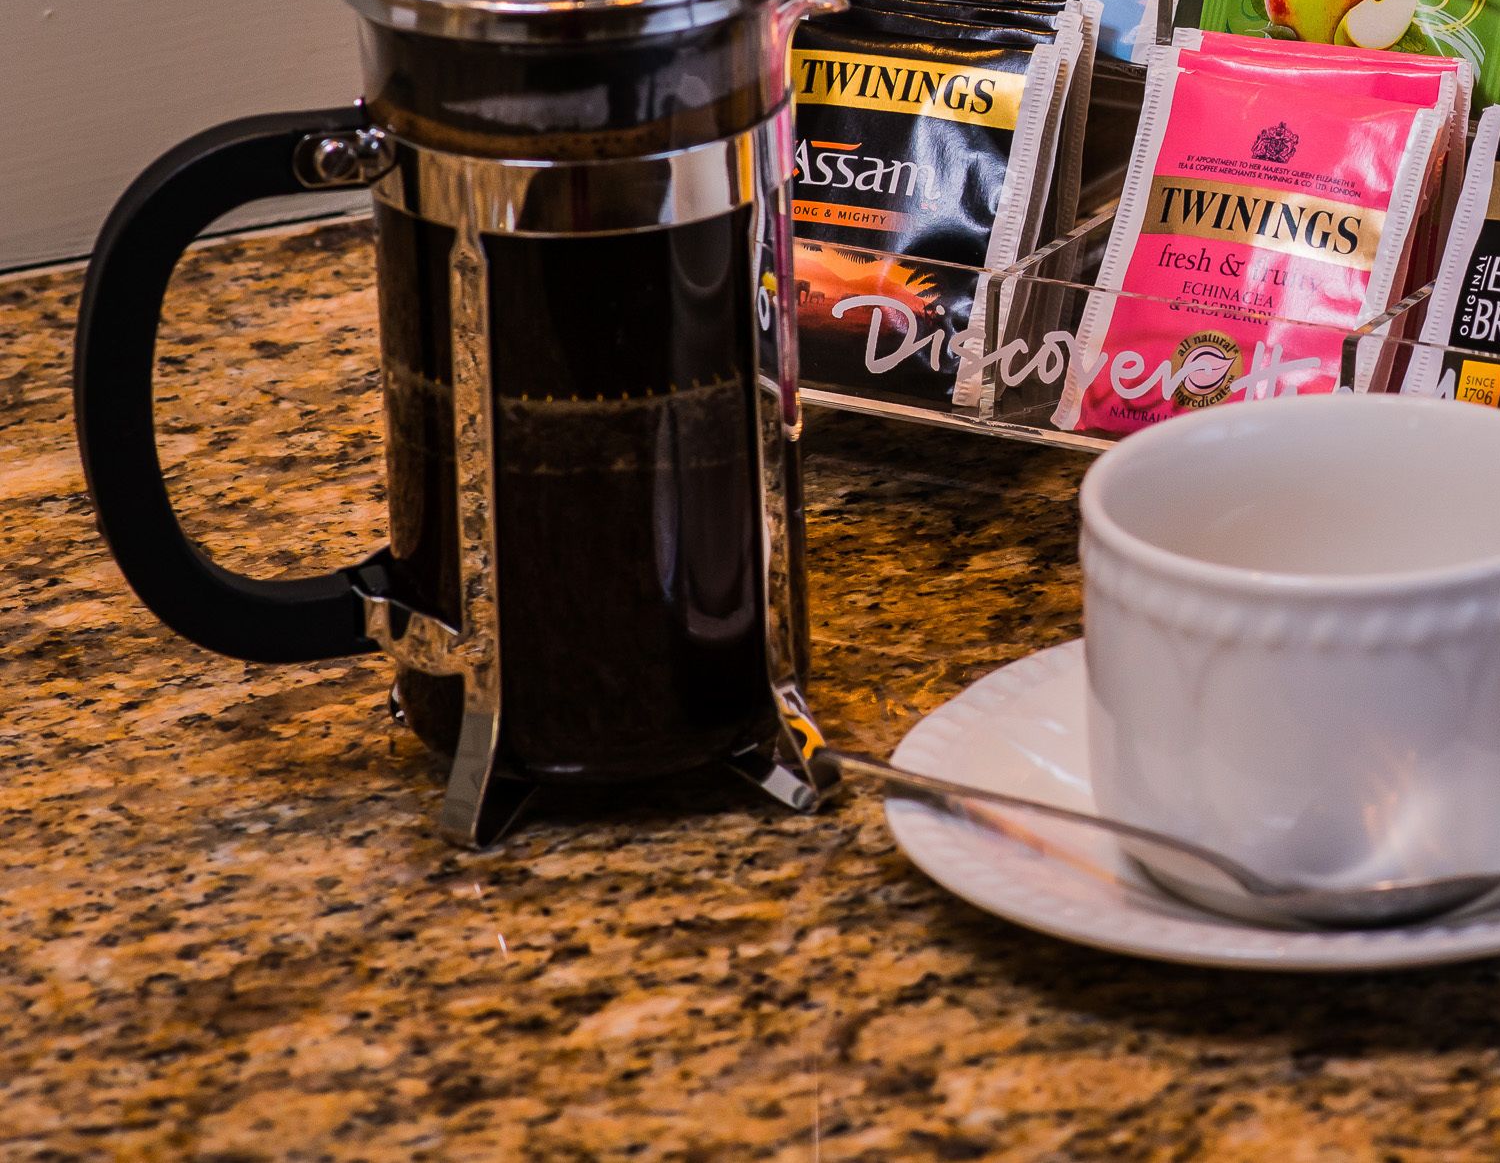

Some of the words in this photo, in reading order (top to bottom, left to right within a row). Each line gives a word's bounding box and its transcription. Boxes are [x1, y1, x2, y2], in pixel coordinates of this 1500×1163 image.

[800, 58, 996, 115] TWININGS
[794, 138, 941, 200] Assam
[824, 209, 832, 218] &
[838, 210, 887, 225] MIGHTY
[1160, 186, 1362, 255] TWININGS
[1158, 243, 1211, 273] fresh
[1219, 253, 1246, 278] &
[1182, 280, 1273, 308] ECHINACEA
[1459, 255, 1489, 336] ORIGINAL
[831, 294, 1212, 400] Discover
[1177, 338, 1191, 357] all
[1462, 387, 1494, 406] 1706
[1465, 374, 1496, 389] SINCE
